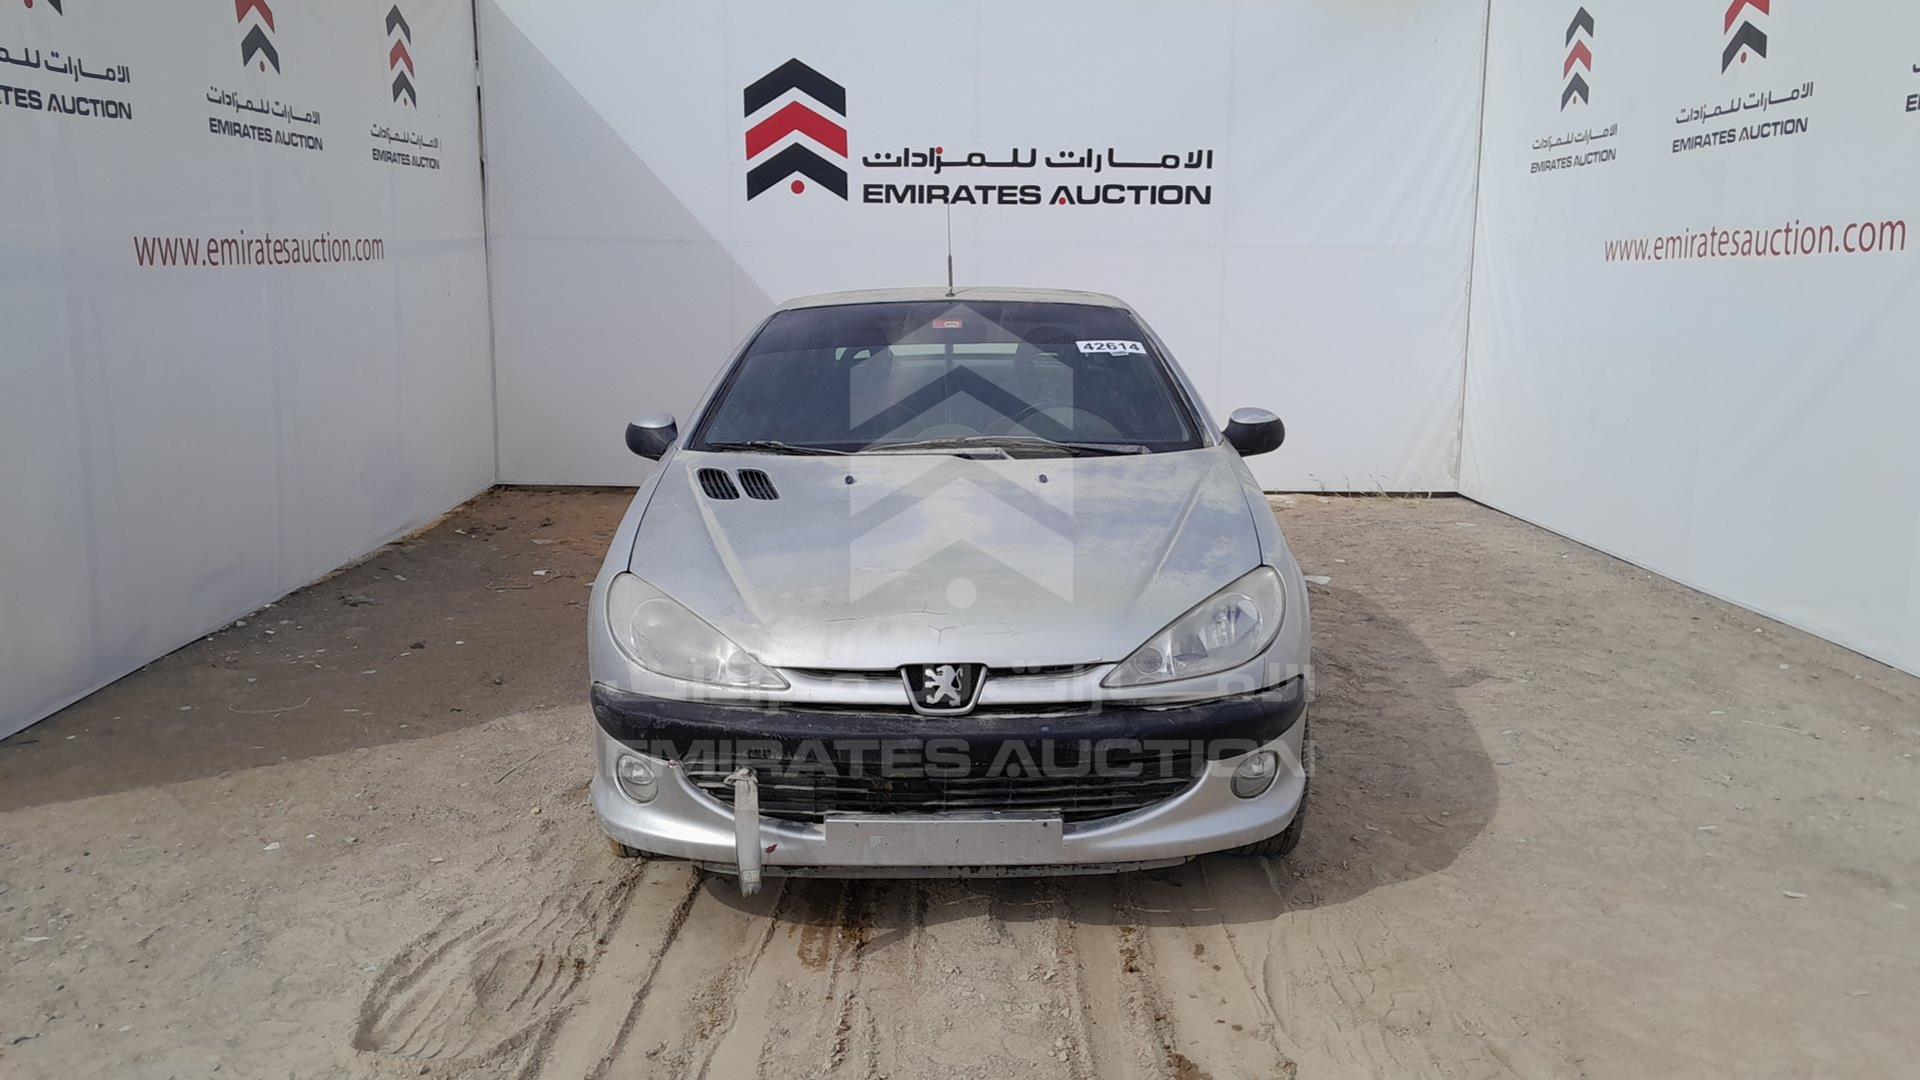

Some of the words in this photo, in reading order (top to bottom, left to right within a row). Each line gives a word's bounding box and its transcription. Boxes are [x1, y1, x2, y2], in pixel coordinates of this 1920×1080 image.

[47, 93, 132, 120] AUCTION
[209, 117, 273, 143] EMIRATES
[274, 130, 323, 151] AUCTION
[1672, 128, 1736, 153] EMIRATES
[1738, 117, 1809, 142] AUCTION
[372, 147, 410, 166] EMIRATES
[411, 155, 440, 170] AUCTION
[1045, 147, 1214, 173] الامارات
[1529, 155, 1573, 174] EMIRATES
[1573, 147, 1616, 167] AUCTION
[863, 184, 1041, 205] EMIRATES
[1049, 184, 1211, 205] AUCTION
[134, 229, 384, 266] www.emiratesauction.com
[1603, 219, 1906, 263] www.emiratesauction.com
[1083, 342, 1140, 351] 42614
